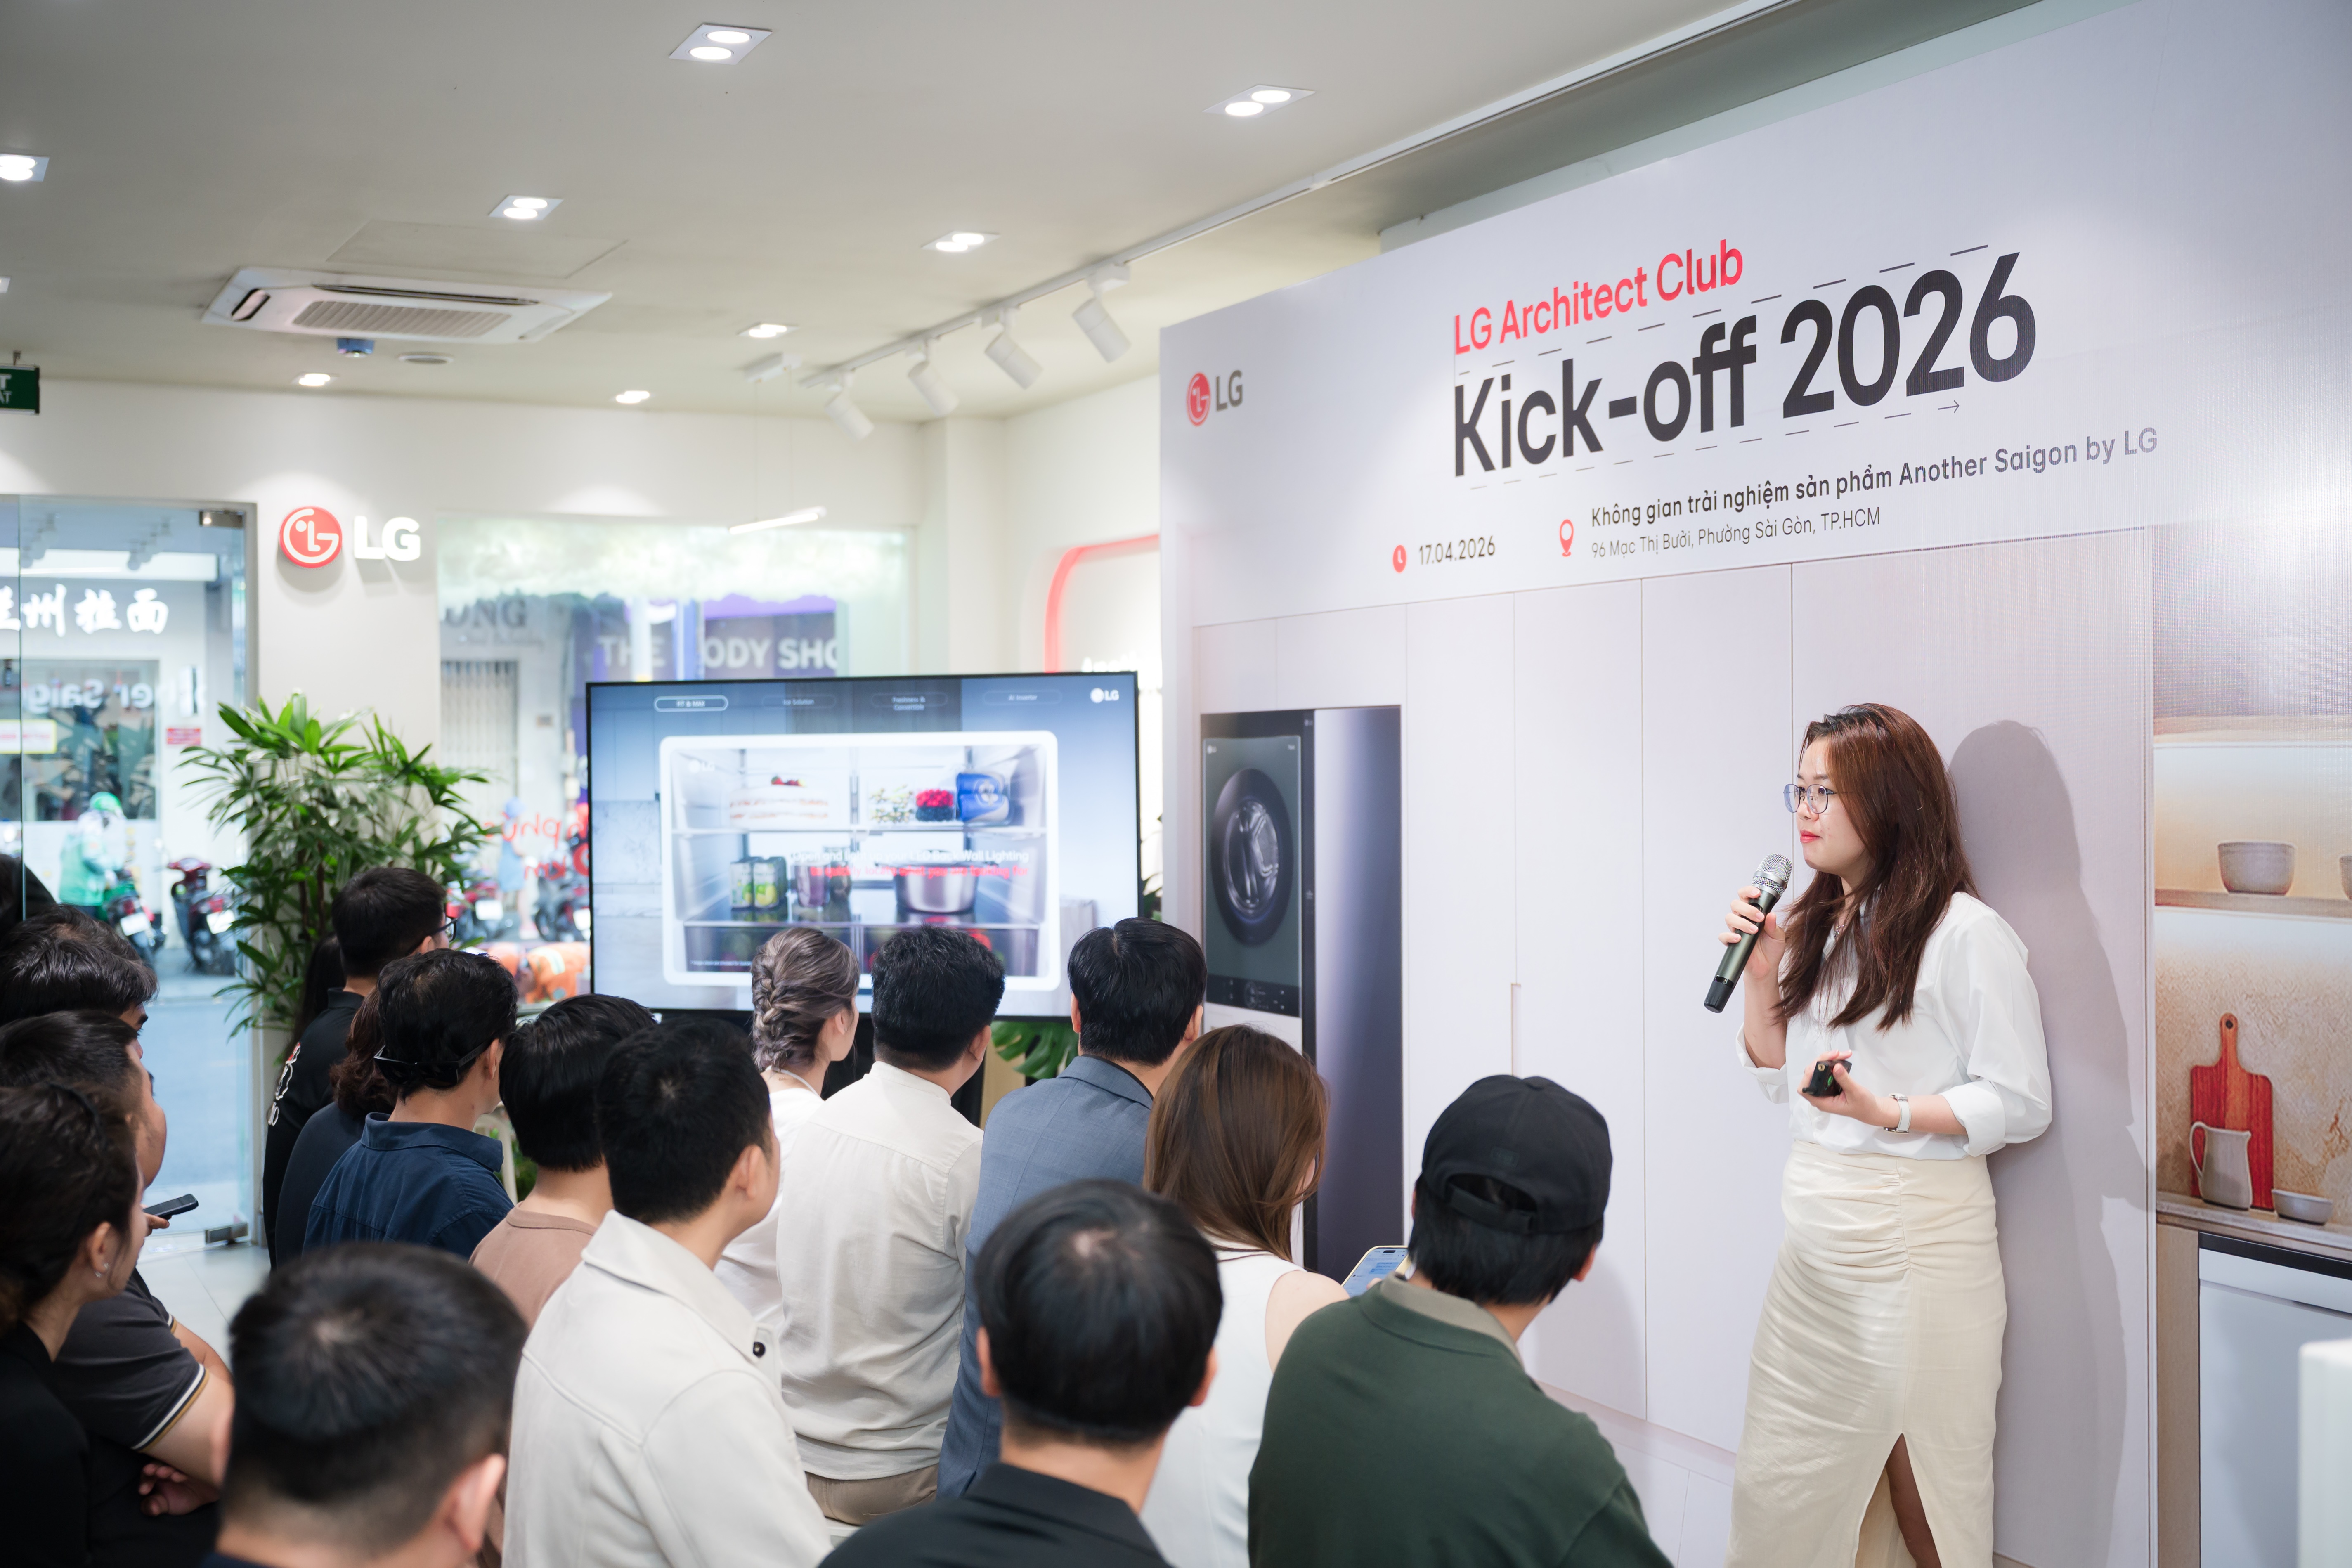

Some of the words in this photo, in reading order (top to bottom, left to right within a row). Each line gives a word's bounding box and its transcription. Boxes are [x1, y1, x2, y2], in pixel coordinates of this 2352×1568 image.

[1455, 307, 1492, 355] LG
[1499, 267, 1648, 344] Architect
[1656, 239, 1744, 301] Club
[1455, 315, 1756, 477] Kick-off
[1780, 252, 2036, 419] 2026
[1215, 369, 1243, 412] LG
[1591, 503, 1641, 527] Không
[1646, 498, 1682, 524] gian
[1688, 490, 1717, 513] trải
[1723, 480, 1789, 513] nghiệm
[1796, 475, 1830, 499] sản
[1837, 464, 1892, 499] phẩm
[1899, 455, 1987, 485] Another
[1995, 443, 2077, 474] Saigon
[2086, 436, 2116, 465] by
[2124, 427, 2158, 456] LG
[354, 515, 421, 561] LG
[1419, 535, 1496, 565] 17.04.2026
[1591, 541, 1606, 558] 96
[1610, 539, 1636, 558] Mạc
[1640, 534, 1659, 555] Thị
[1663, 530, 1694, 549] Bưởi,
[1698, 524, 1750, 545] Phường
[1755, 518, 1777, 539] Sài
[1782, 515, 1816, 536] Gòn,
[1821, 506, 1880, 531] TP.HCM
[702, 637, 771, 669] ODY
[777, 636, 838, 670] SHO
[1104, 689, 1120, 701] LG
